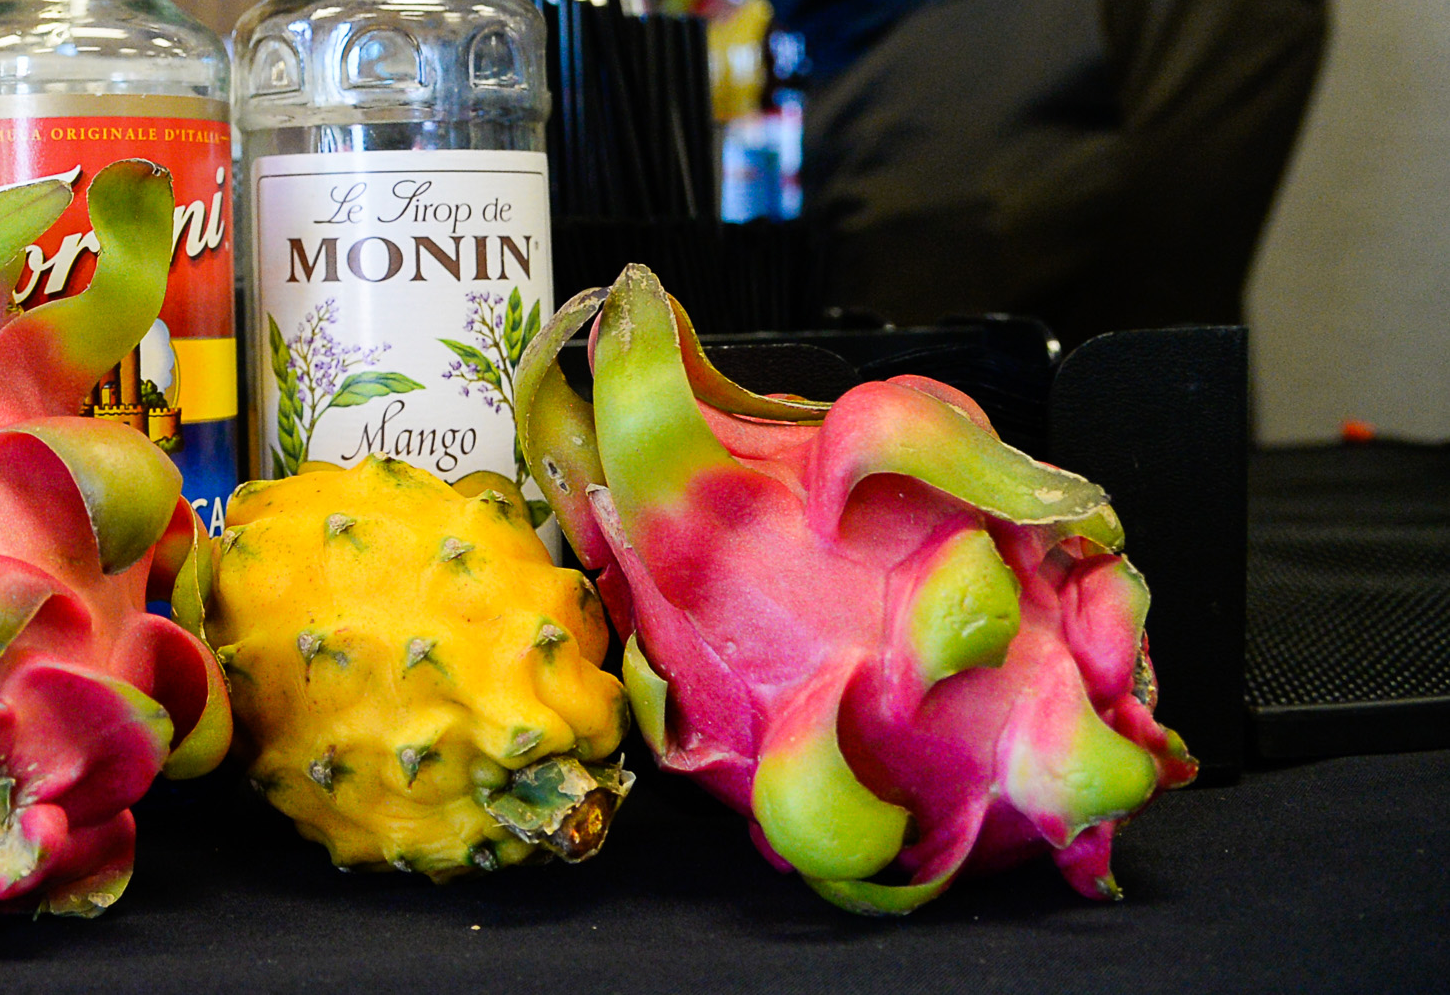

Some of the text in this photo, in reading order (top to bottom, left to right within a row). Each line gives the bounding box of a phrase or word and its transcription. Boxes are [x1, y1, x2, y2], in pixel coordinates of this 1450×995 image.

[50, 127, 158, 142] ORIGINALE
[164, 128, 221, 144] D'ITALIA
[313, 180, 512, 234] Le Sirop de
[286, 235, 532, 283] MONIN
[341, 399, 477, 472] Mango
